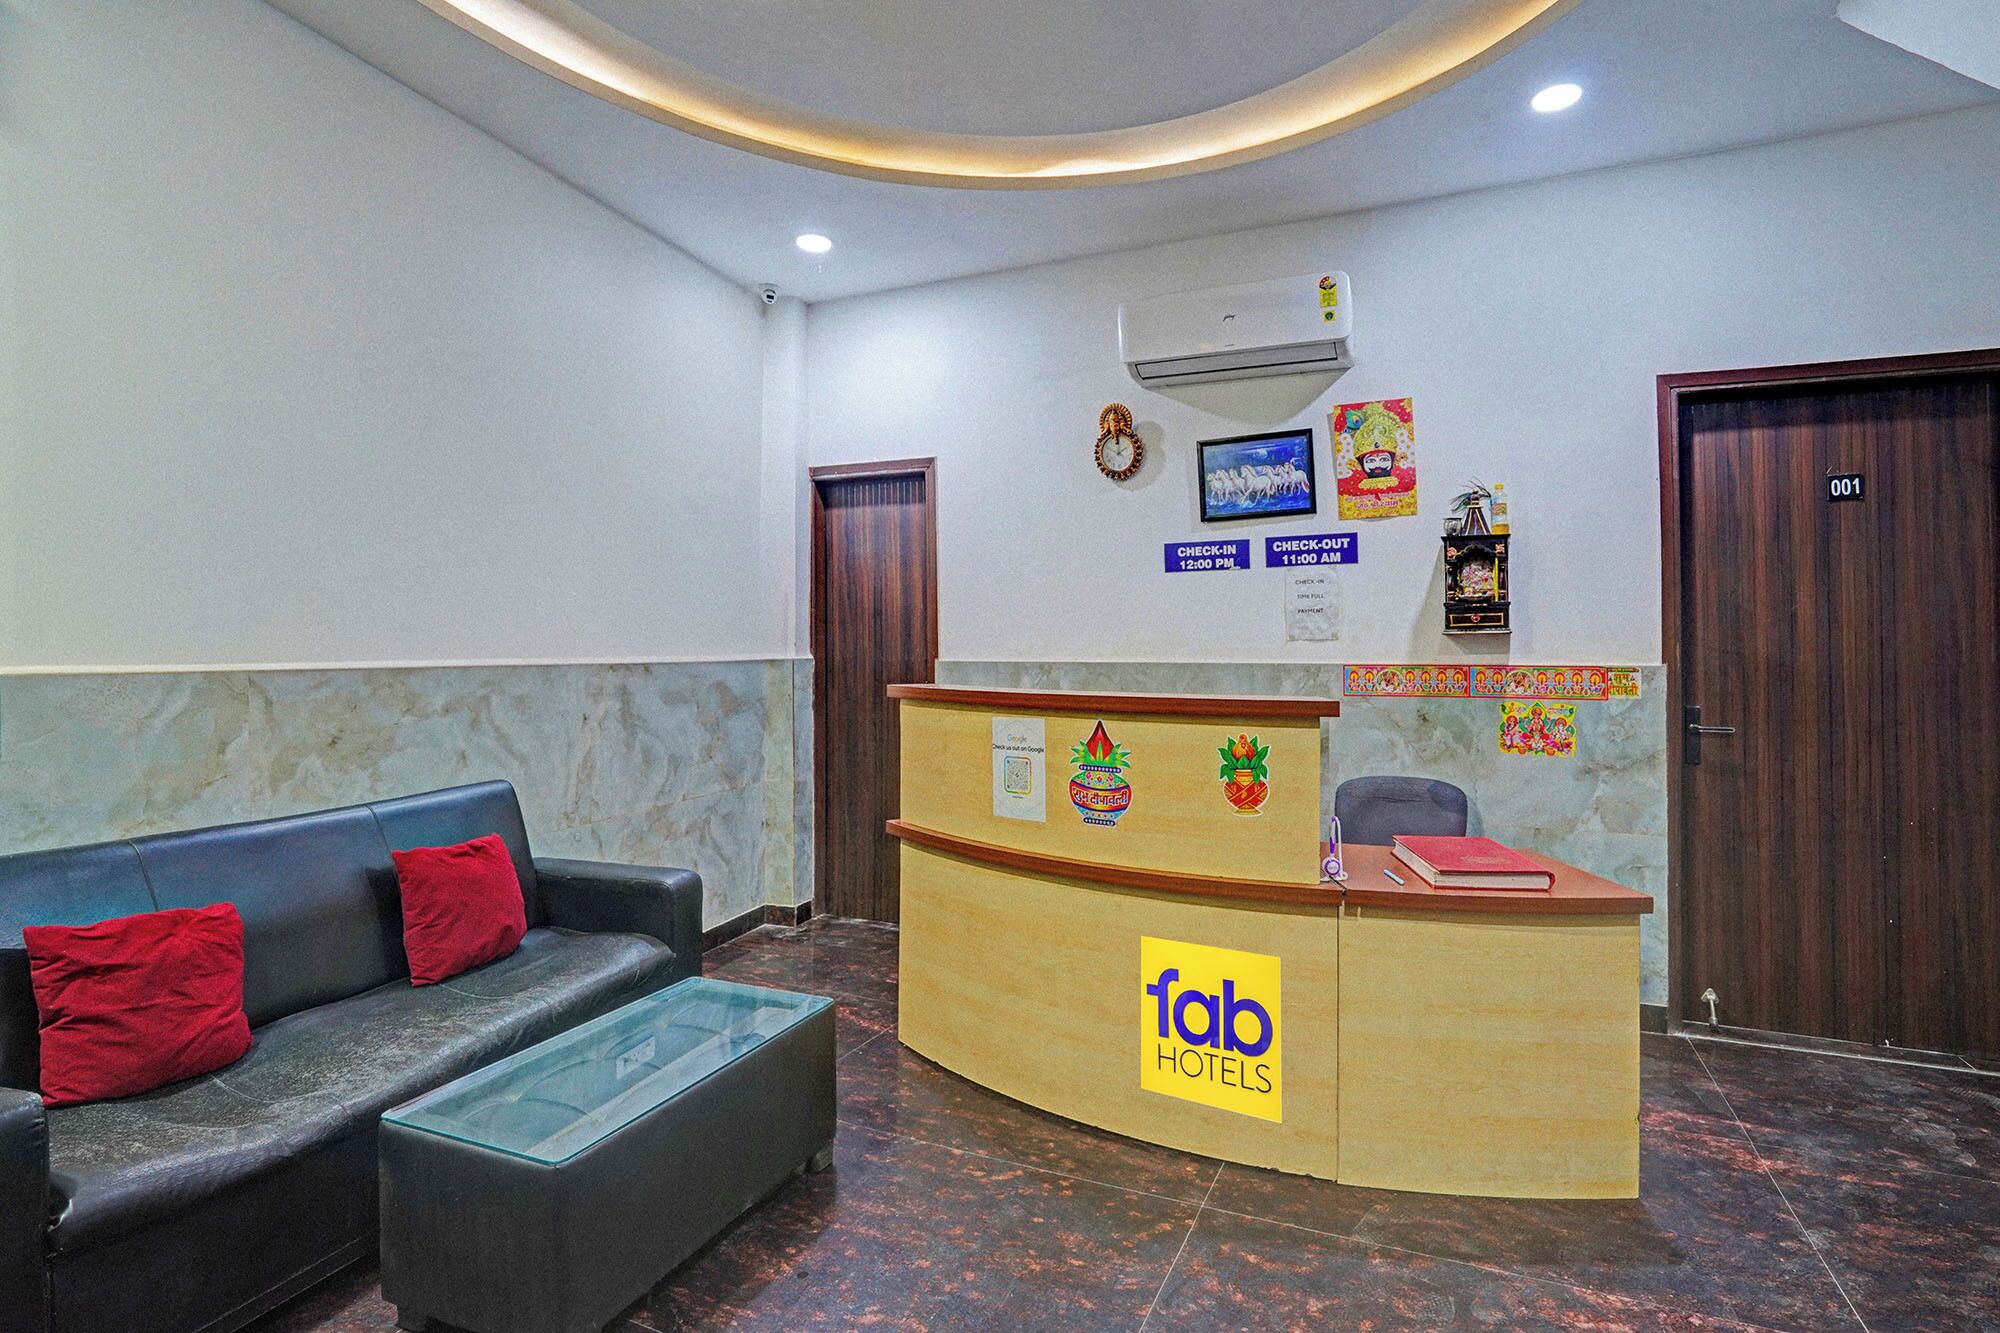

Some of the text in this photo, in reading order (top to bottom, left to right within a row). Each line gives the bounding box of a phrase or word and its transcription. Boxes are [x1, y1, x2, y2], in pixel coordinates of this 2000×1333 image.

[1831, 478, 1860, 496] 001
[1177, 545, 1236, 557] CHECK-IN
[1273, 538, 1350, 552] CHECK-OUT
[1180, 558, 1234, 570] 12:00 PM
[1282, 552, 1341, 564] 11:00 AM
[1028, 745, 1044, 754] Google
[1072, 787, 1128, 806] शुभ दीपावली
[1146, 968, 1273, 1057] fab
[1158, 1043, 1272, 1094] HOTELS
